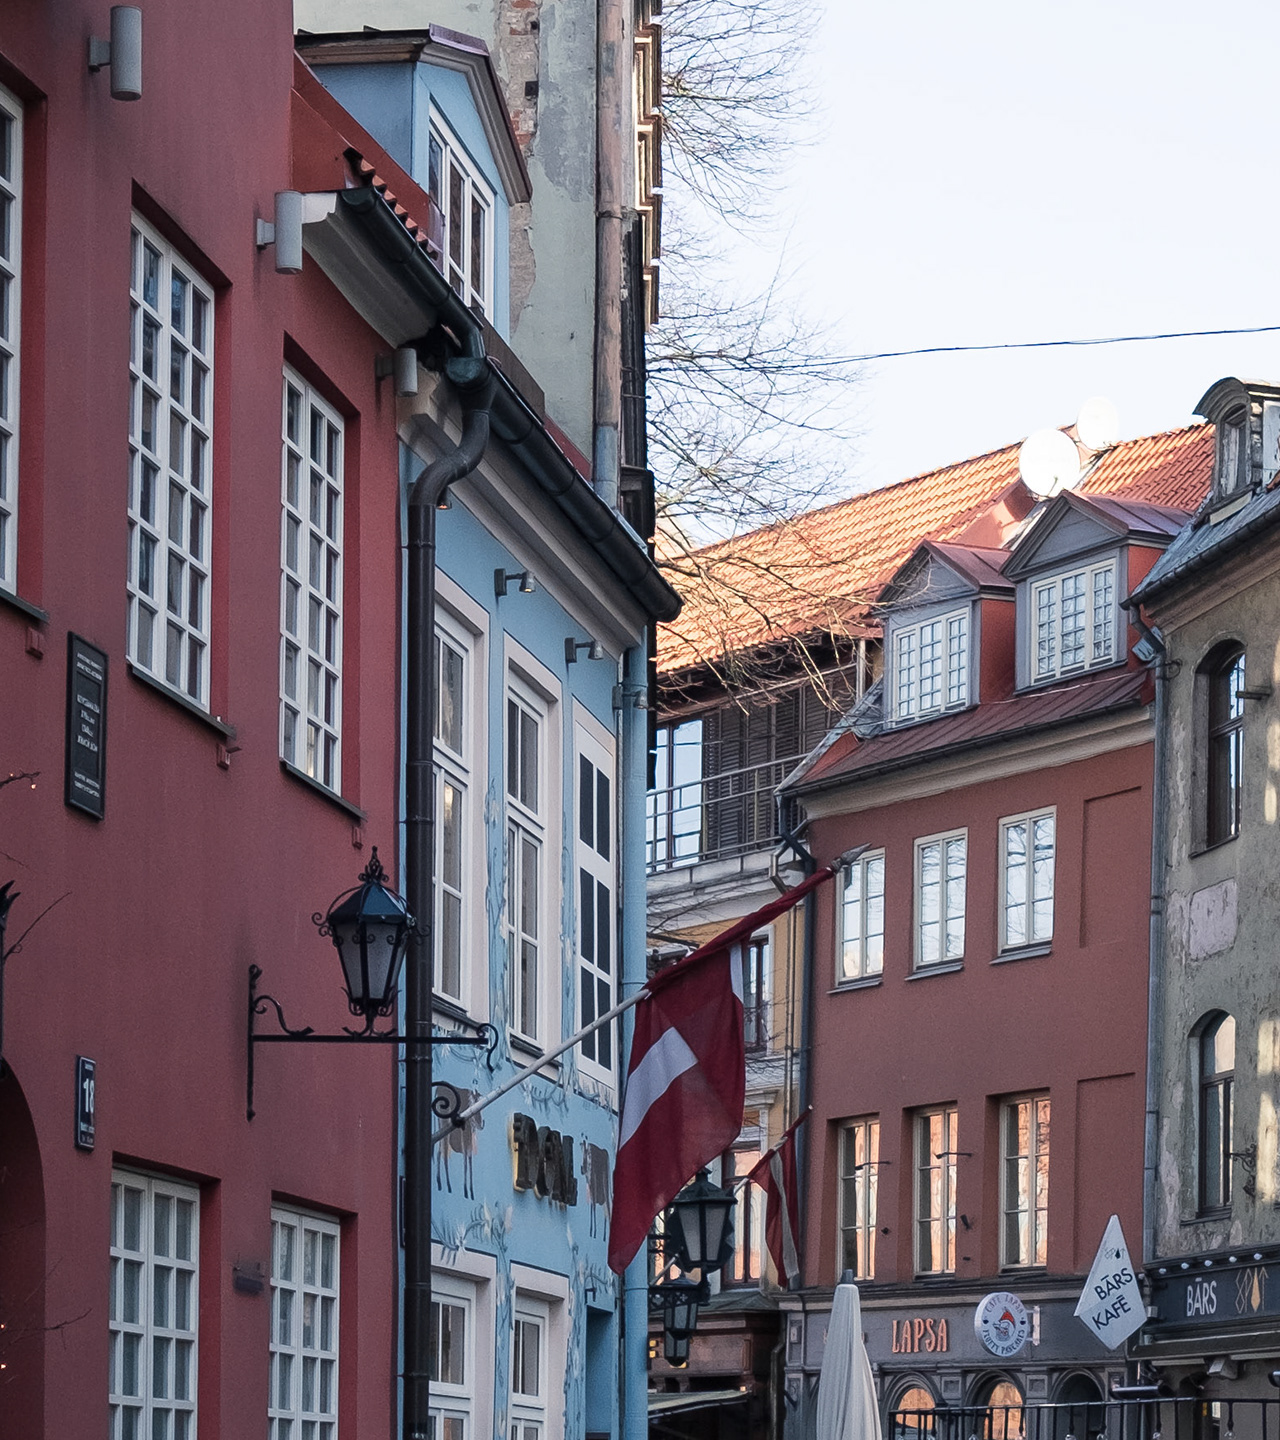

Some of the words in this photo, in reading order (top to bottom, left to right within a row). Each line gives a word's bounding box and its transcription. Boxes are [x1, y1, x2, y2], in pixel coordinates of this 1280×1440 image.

[83, 1078, 95, 1113] 18
[1094, 1267, 1134, 1300] BĀRS
[1186, 1277, 1217, 1317] BĀRS
[892, 1318, 948, 1353] LAPSA
